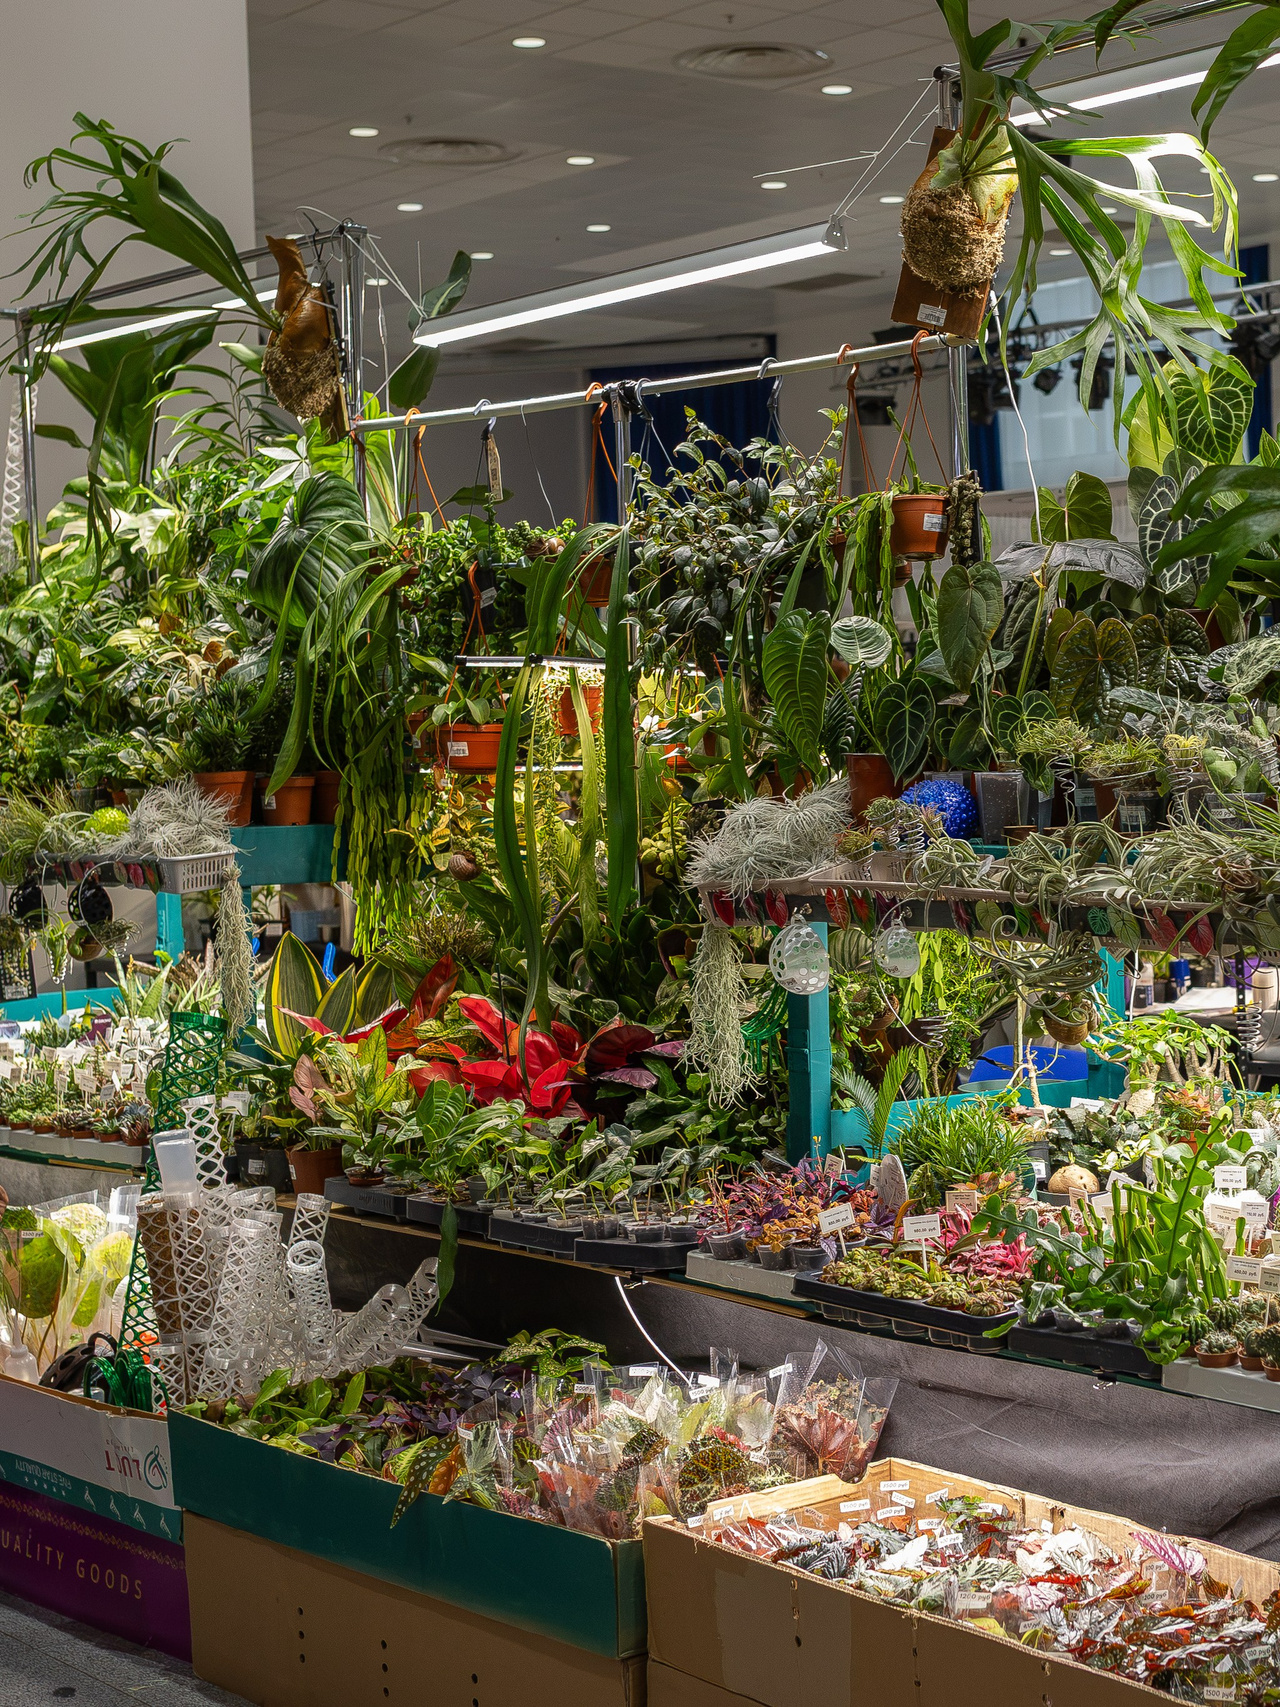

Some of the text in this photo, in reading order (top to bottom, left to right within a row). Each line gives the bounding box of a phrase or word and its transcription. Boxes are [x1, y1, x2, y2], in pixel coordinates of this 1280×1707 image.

[15, 1459, 43, 1479] QUALITY
[41, 1468, 58, 1485] STAR
[1, 1529, 142, 1600] UALITY GOODS
[977, 1593, 991, 1601] руб
[1156, 1591, 1167, 1599] руб
[1258, 1647, 1271, 1656] руб
[1206, 1690, 1234, 1699] 1500 руб
